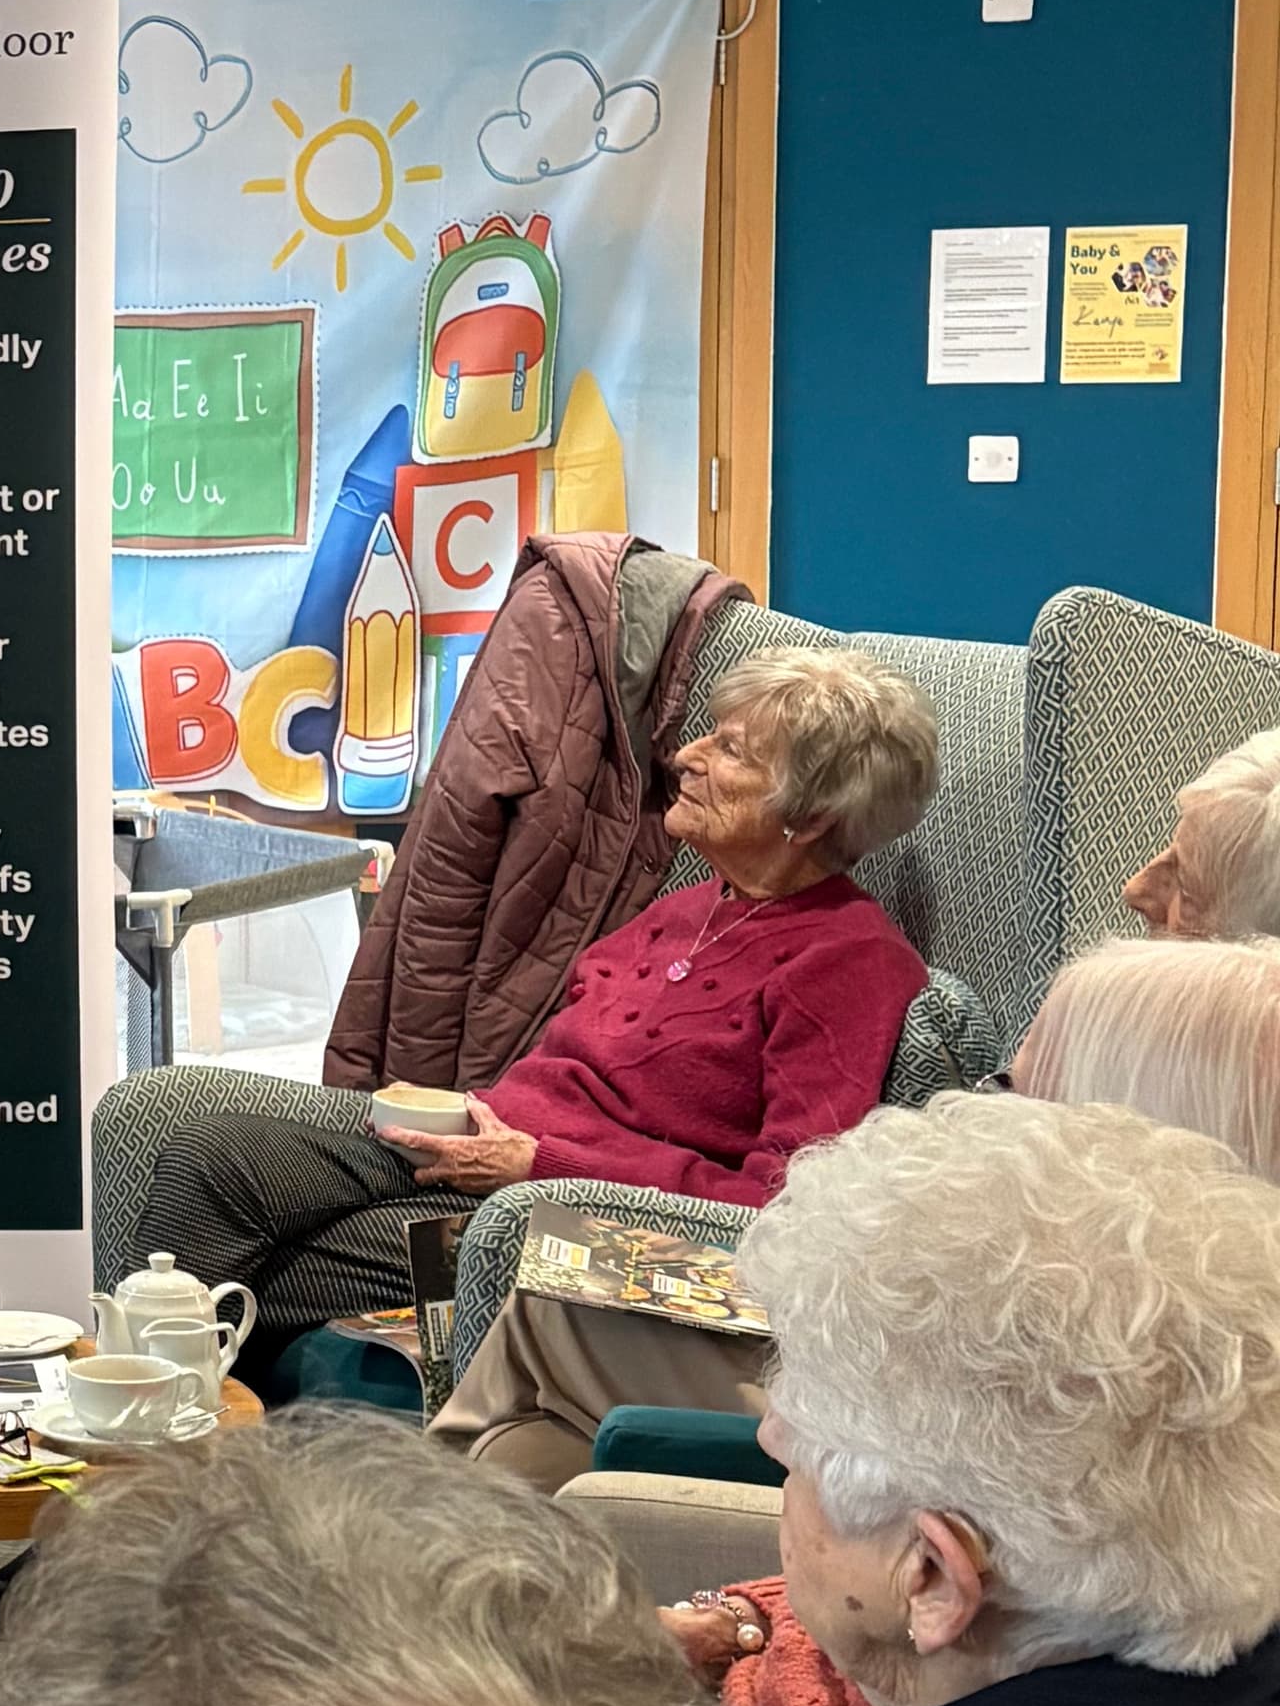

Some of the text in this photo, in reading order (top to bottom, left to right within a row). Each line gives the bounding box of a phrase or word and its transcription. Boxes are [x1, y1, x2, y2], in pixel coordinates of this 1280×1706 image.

[1071, 243, 1120, 261] Baby &
[1070, 263, 1098, 275] You
[22, 490, 59, 512] or
[435, 500, 493, 589] C
